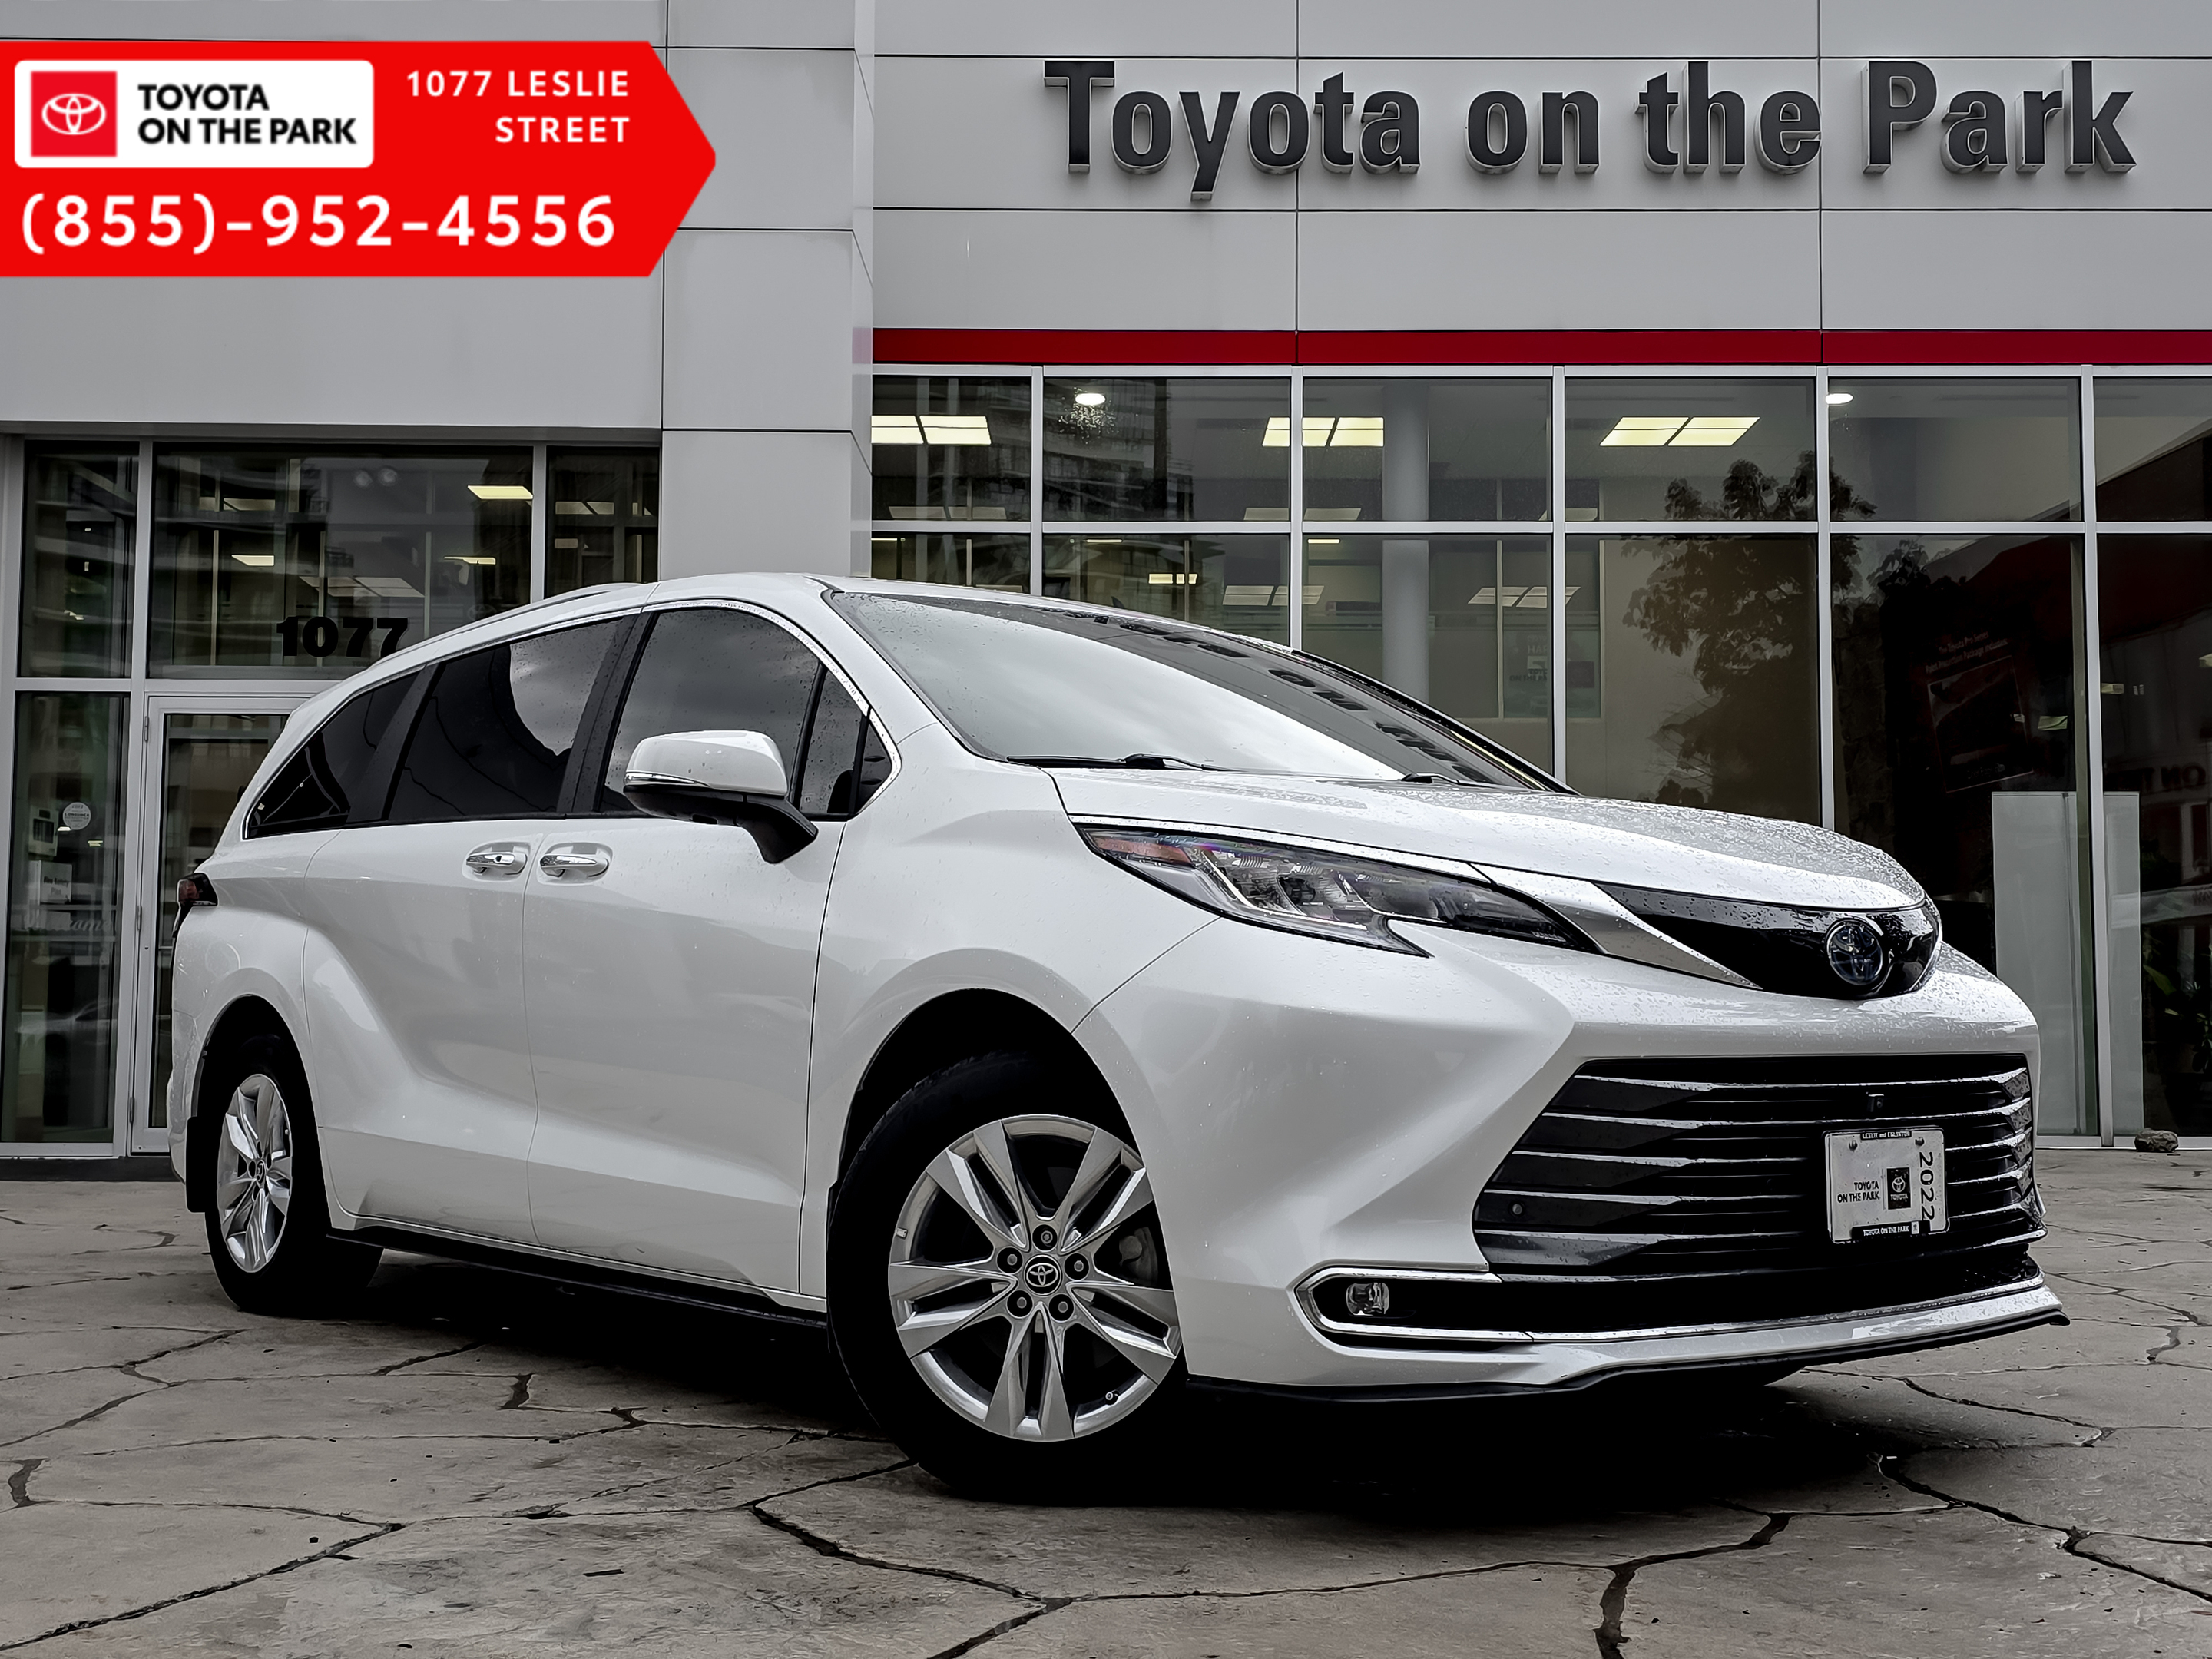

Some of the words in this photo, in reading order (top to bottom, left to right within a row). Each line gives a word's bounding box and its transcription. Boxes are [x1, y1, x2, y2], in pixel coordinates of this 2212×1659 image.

[1044, 60, 1421, 201] Toyota
[1465, 90, 1600, 175] on
[1635, 60, 1822, 175] the
[1862, 60, 2137, 175] Park
[276, 615, 408, 657] 1077
[1837, 1194, 1848, 1203] ON
[1849, 1193, 1862, 1202] THE
[1863, 1191, 1879, 1200] PARK
[1854, 1181, 1879, 1190] TOYOTA
[1919, 1151, 1936, 1220] 2022
